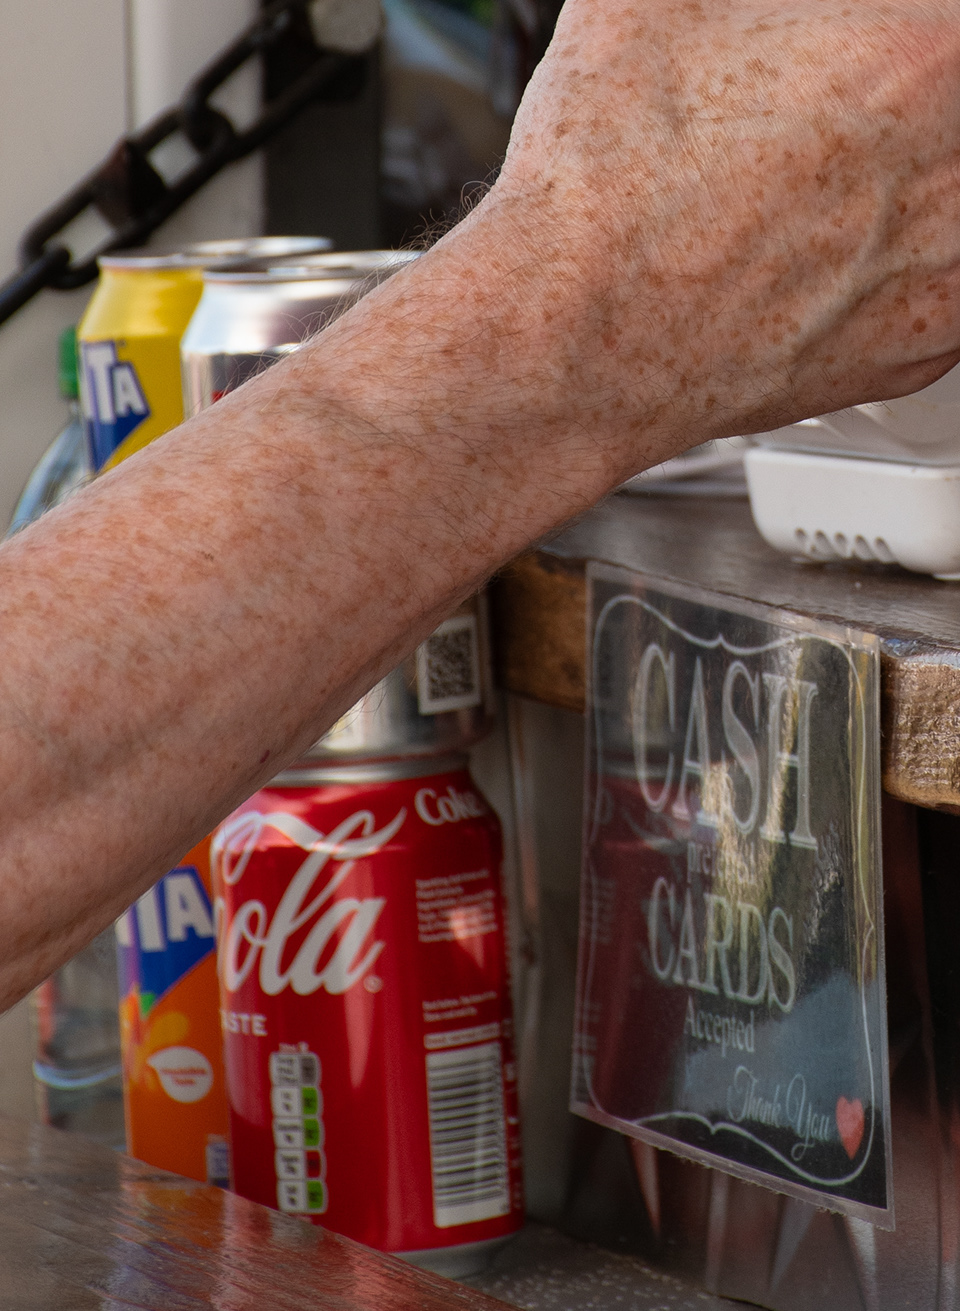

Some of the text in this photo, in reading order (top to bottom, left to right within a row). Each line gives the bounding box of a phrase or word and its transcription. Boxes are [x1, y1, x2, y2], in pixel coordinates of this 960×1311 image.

[632, 643, 819, 851] CASH
[649, 876, 797, 1015] CARDS
[683, 994, 756, 1058] Accepted
[727, 1065, 830, 1162] Thank You
